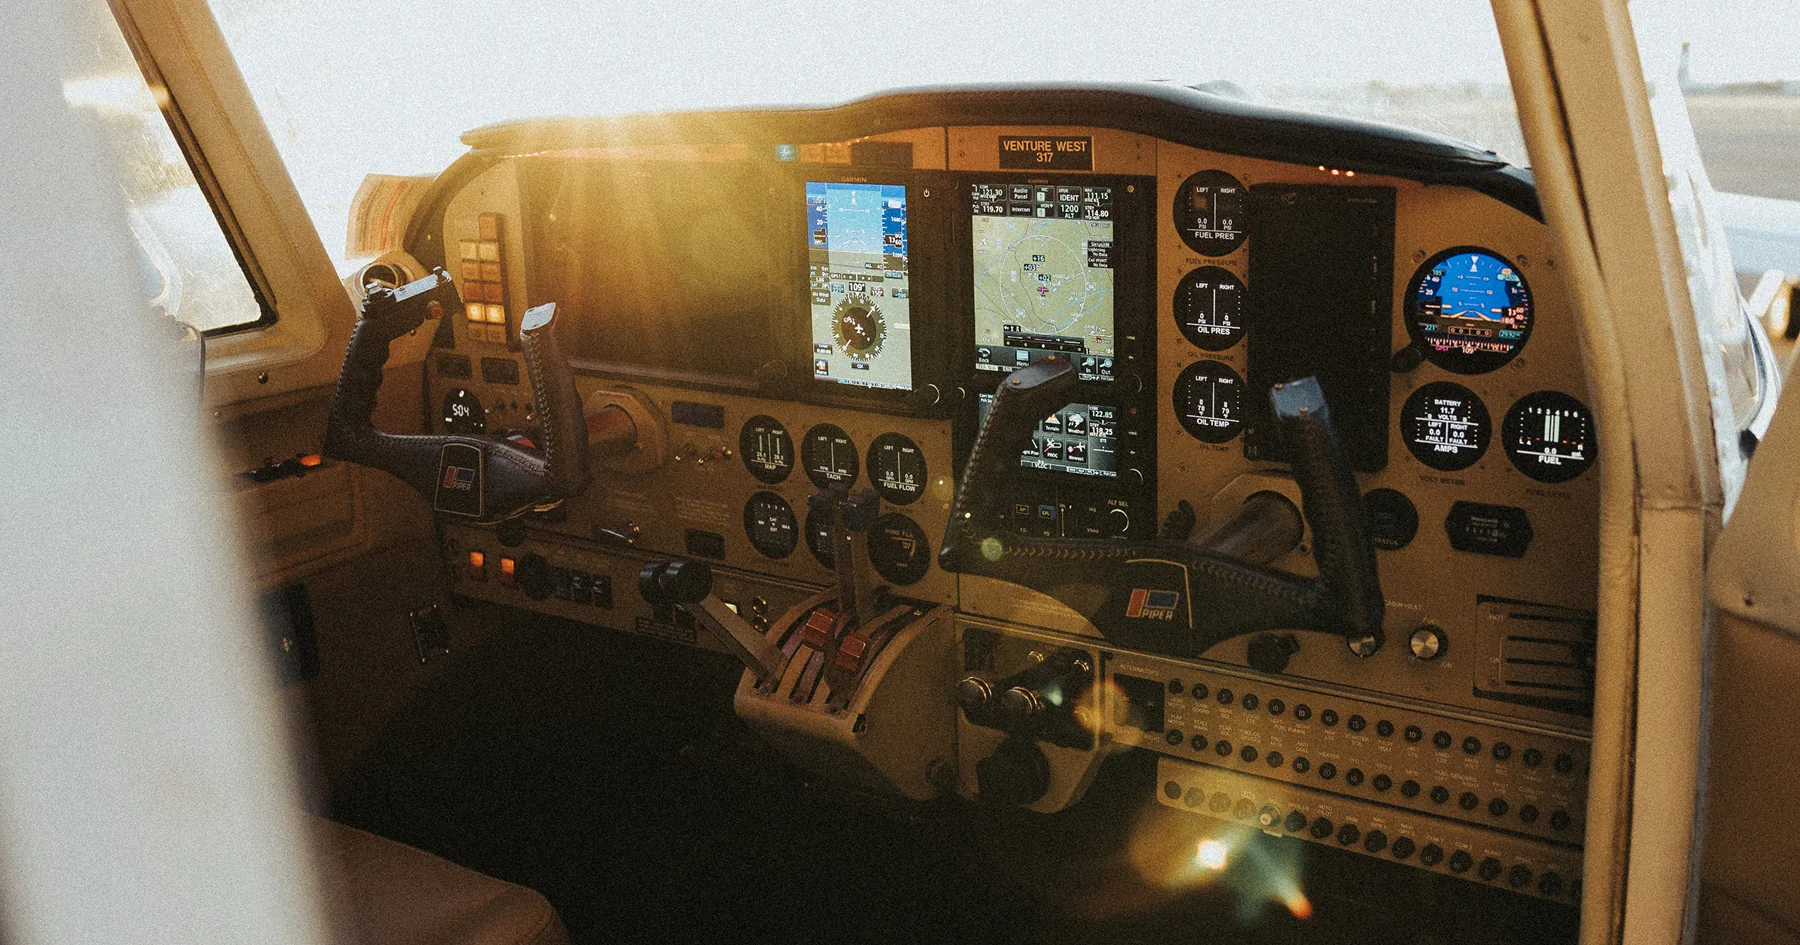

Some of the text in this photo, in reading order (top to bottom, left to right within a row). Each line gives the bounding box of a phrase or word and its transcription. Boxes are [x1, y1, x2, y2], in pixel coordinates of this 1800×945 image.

[1003, 140, 1087, 152] VENTURE WEST
[1036, 152, 1053, 162] 317
[1092, 427, 1113, 435] 118.25
[1434, 444, 1458, 453] AMPS
[1538, 455, 1561, 465] FUEL
[452, 482, 471, 490] PIPER
[1142, 609, 1173, 619] PIPER
